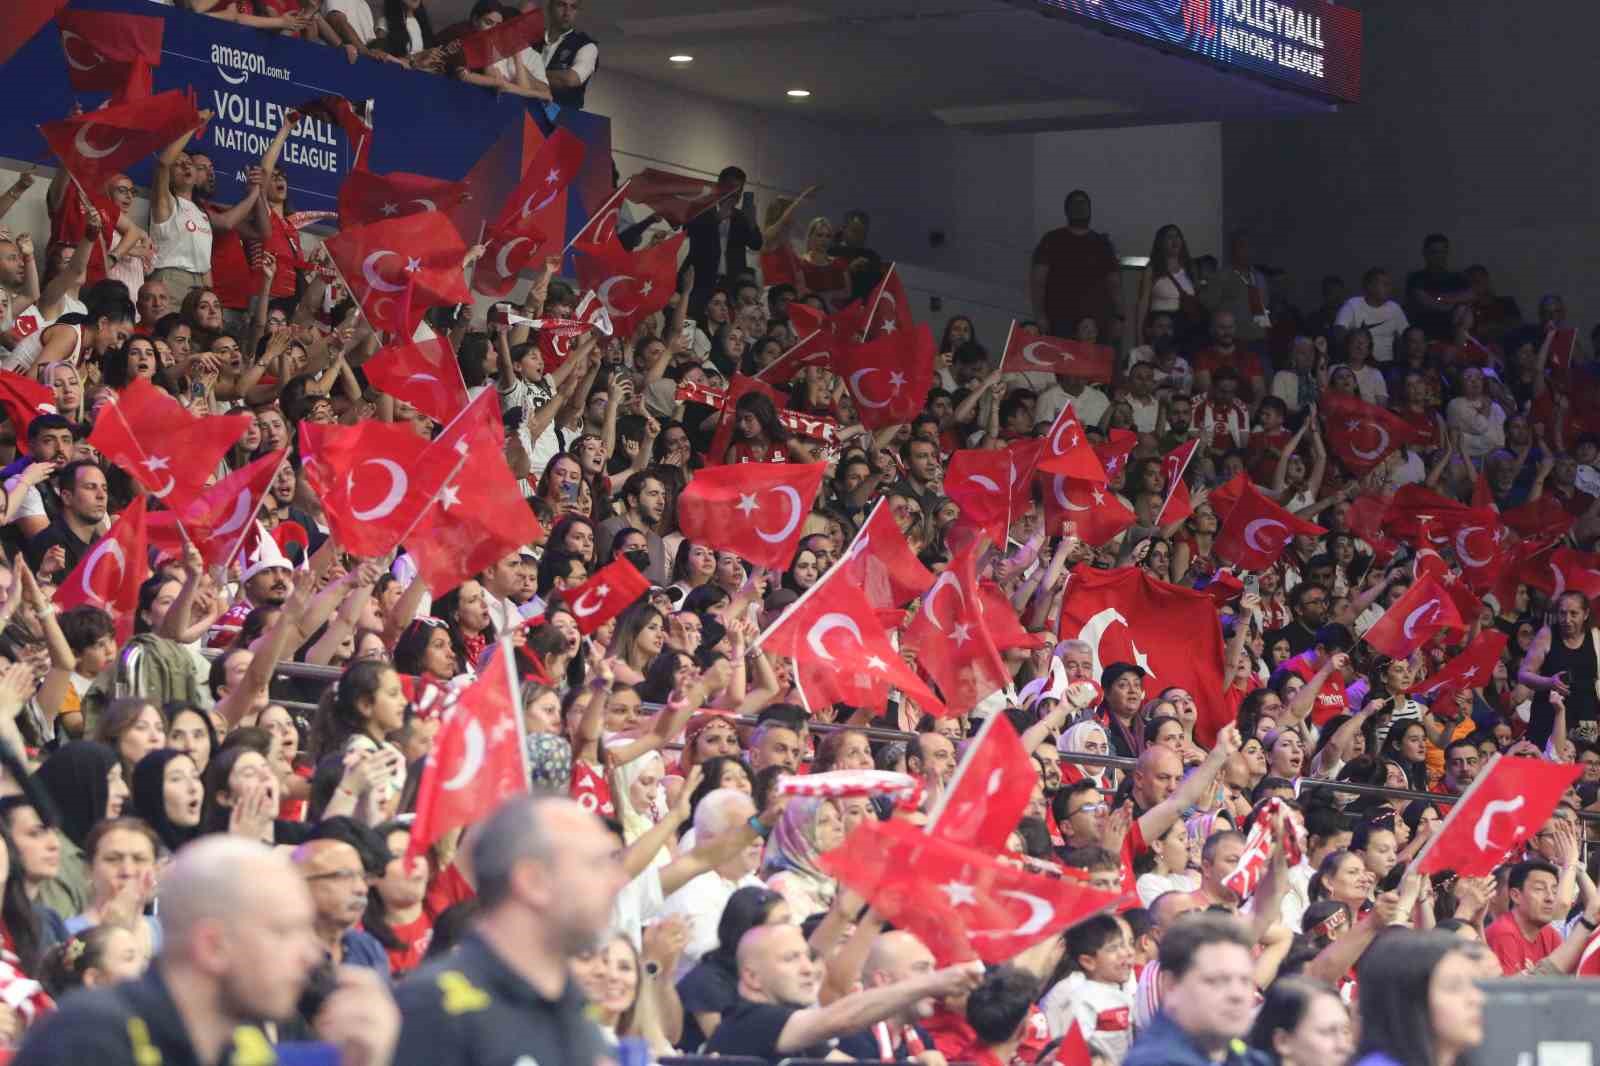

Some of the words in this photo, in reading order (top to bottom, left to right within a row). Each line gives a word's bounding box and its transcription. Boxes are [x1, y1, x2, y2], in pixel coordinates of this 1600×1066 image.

[1220, 25, 1275, 61] NATIONS
[1278, 42, 1325, 78] LEAGUE
[214, 126, 275, 156] NATION
[283, 142, 337, 173] LEAGUE
